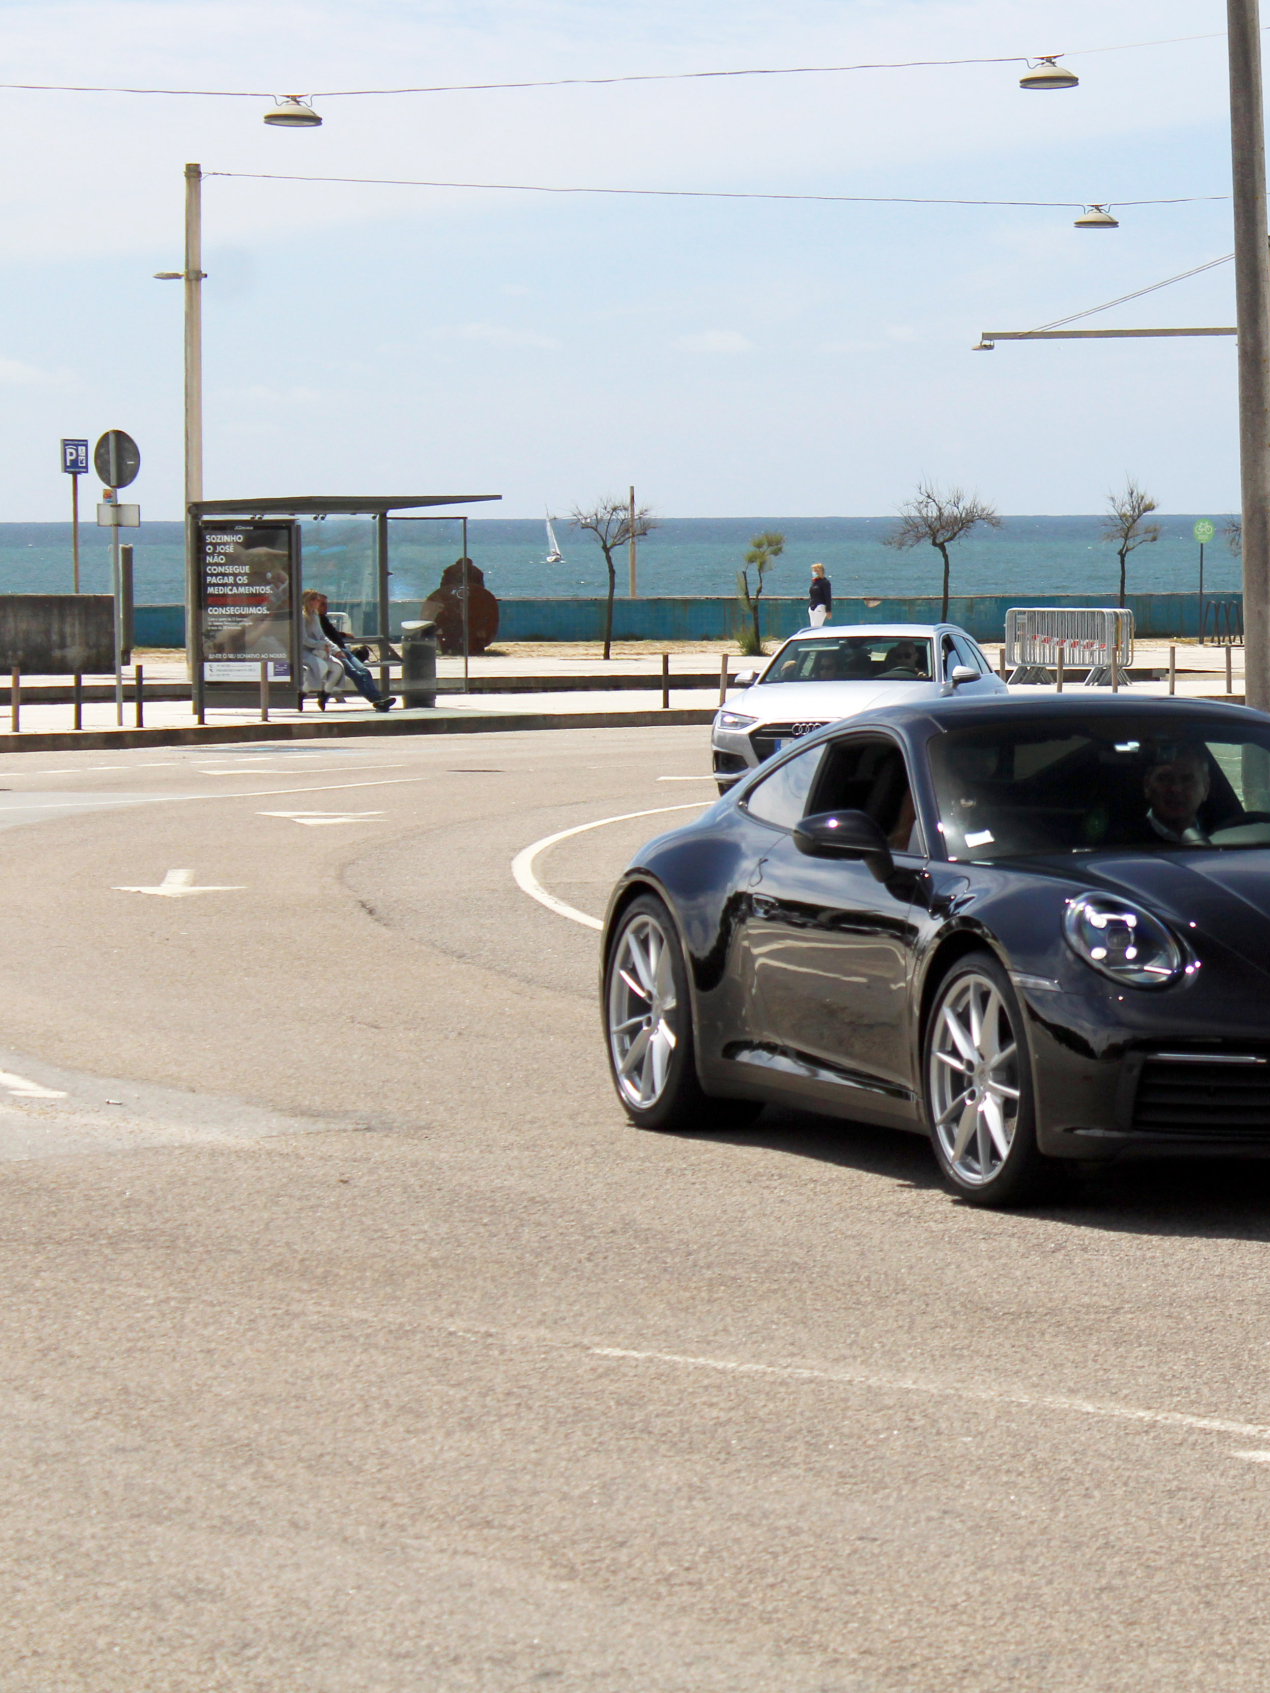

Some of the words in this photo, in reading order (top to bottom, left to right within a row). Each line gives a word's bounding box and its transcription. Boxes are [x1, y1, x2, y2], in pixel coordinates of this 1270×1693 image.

[205, 534, 243, 543] SOZINHO
[205, 545, 213, 553] O
[215, 542, 234, 553] JOSÉ
[206, 553, 226, 563] NÃO
[206, 565, 250, 574] CONSEGUE
[206, 575, 234, 584] PAGAR
[236, 575, 248, 584] OS
[207, 586, 273, 595] MEDICAMENTOS.
[207, 606, 270, 615] CONSEGUIMOS.
